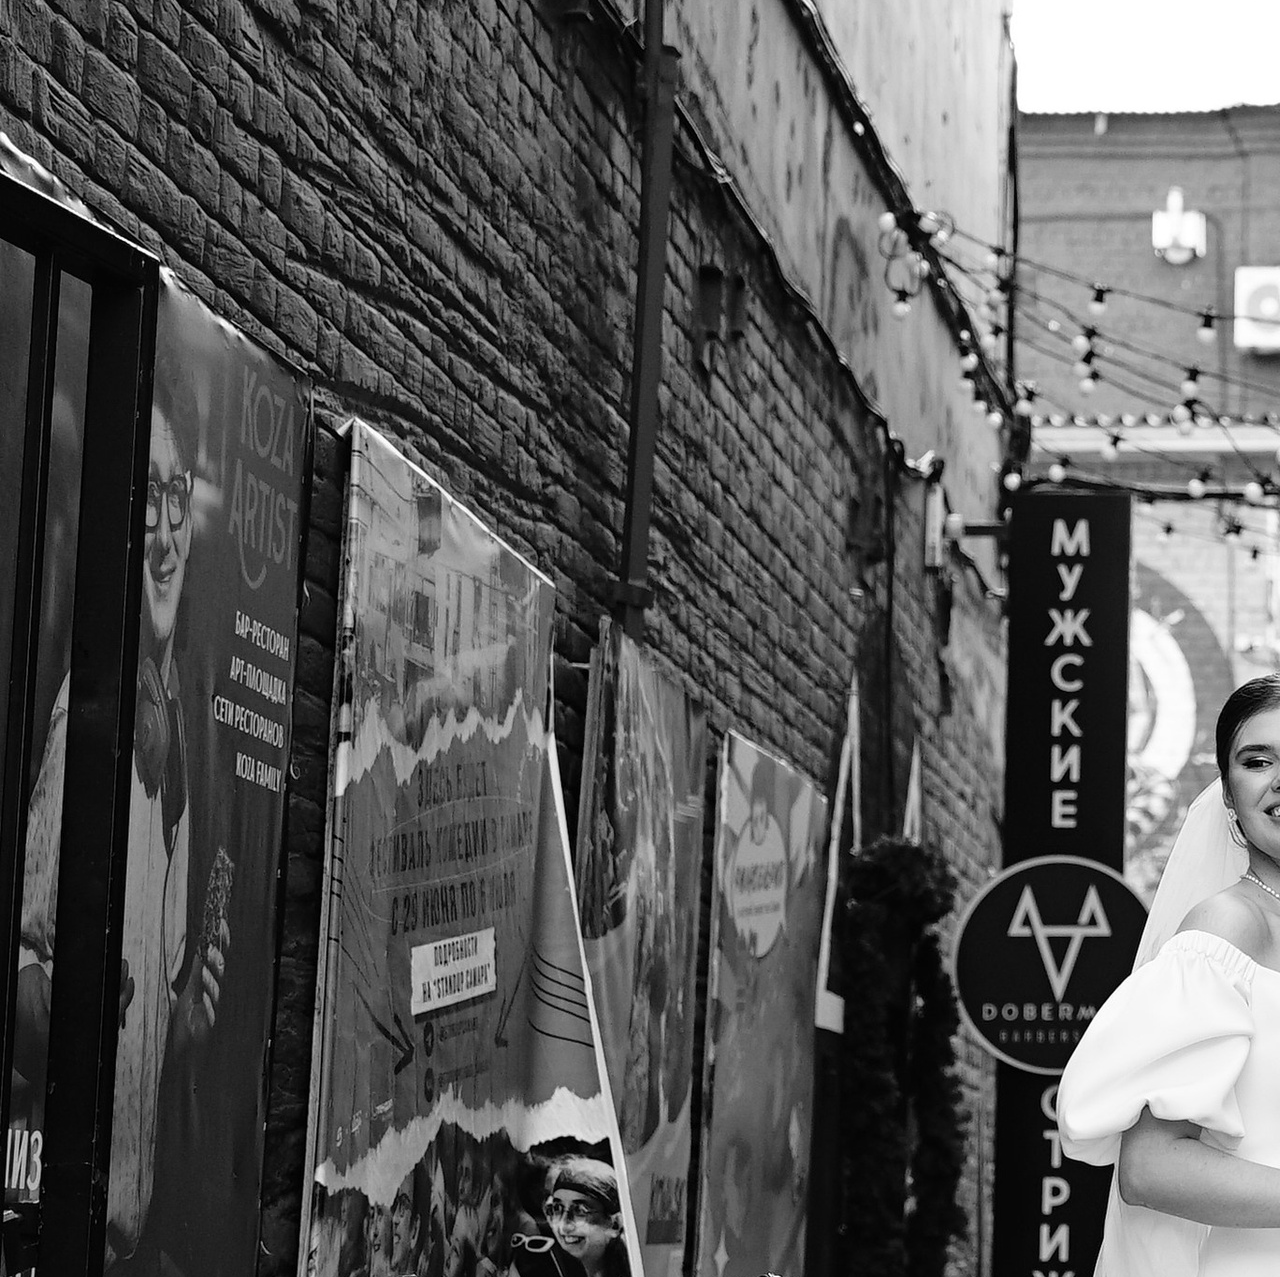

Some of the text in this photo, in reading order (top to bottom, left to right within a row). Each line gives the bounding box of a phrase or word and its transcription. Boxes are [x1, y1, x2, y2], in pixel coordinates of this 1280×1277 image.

[241, 364, 294, 477] KOZA
[228, 458, 298, 589] ARTIST
[235, 610, 290, 662] БАР-РЕСТОРАН
[229, 656, 287, 706] АРТ-ПЛОЩАДКА
[1044, 518, 1093, 828] МУЖСКИЕ
[213, 695, 285, 749] СЕТИ РЕСТОРАНОВ
[235, 751, 282, 793] KOZA FAMILY
[391, 896, 398, 936] С
[404, 891, 418, 933] 29
[422, 883, 458, 929] ИЮНЯ
[461, 880, 477, 919] ПО
